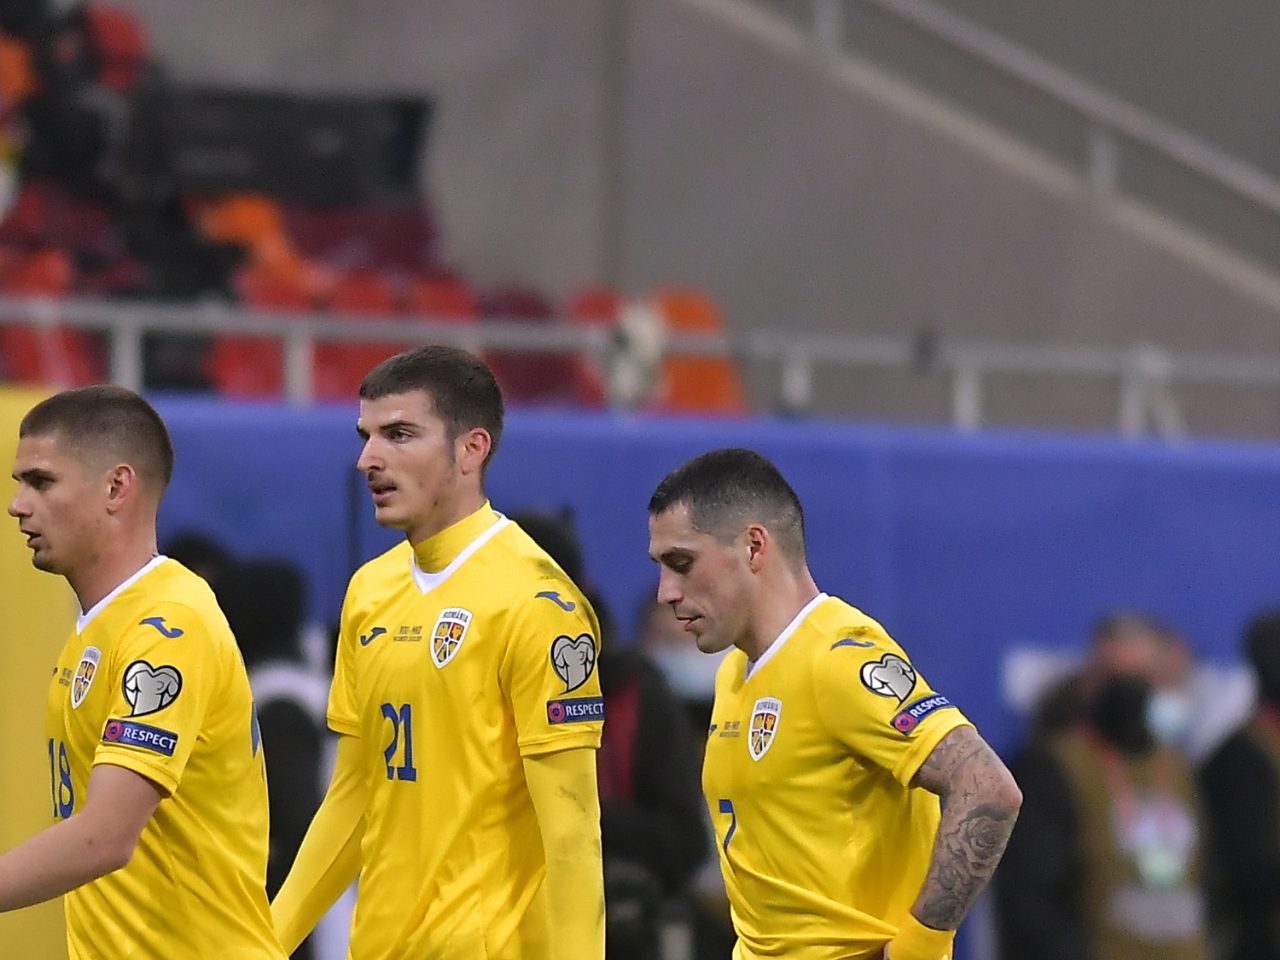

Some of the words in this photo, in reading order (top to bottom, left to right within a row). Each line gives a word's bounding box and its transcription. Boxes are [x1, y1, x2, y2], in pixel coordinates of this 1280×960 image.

[565, 703, 604, 717] RESPECT
[909, 696, 950, 718] RESPECT
[123, 727, 177, 750] RESPECT
[381, 703, 417, 782] 21
[48, 738, 75, 819] 18
[719, 799, 737, 855] 7
